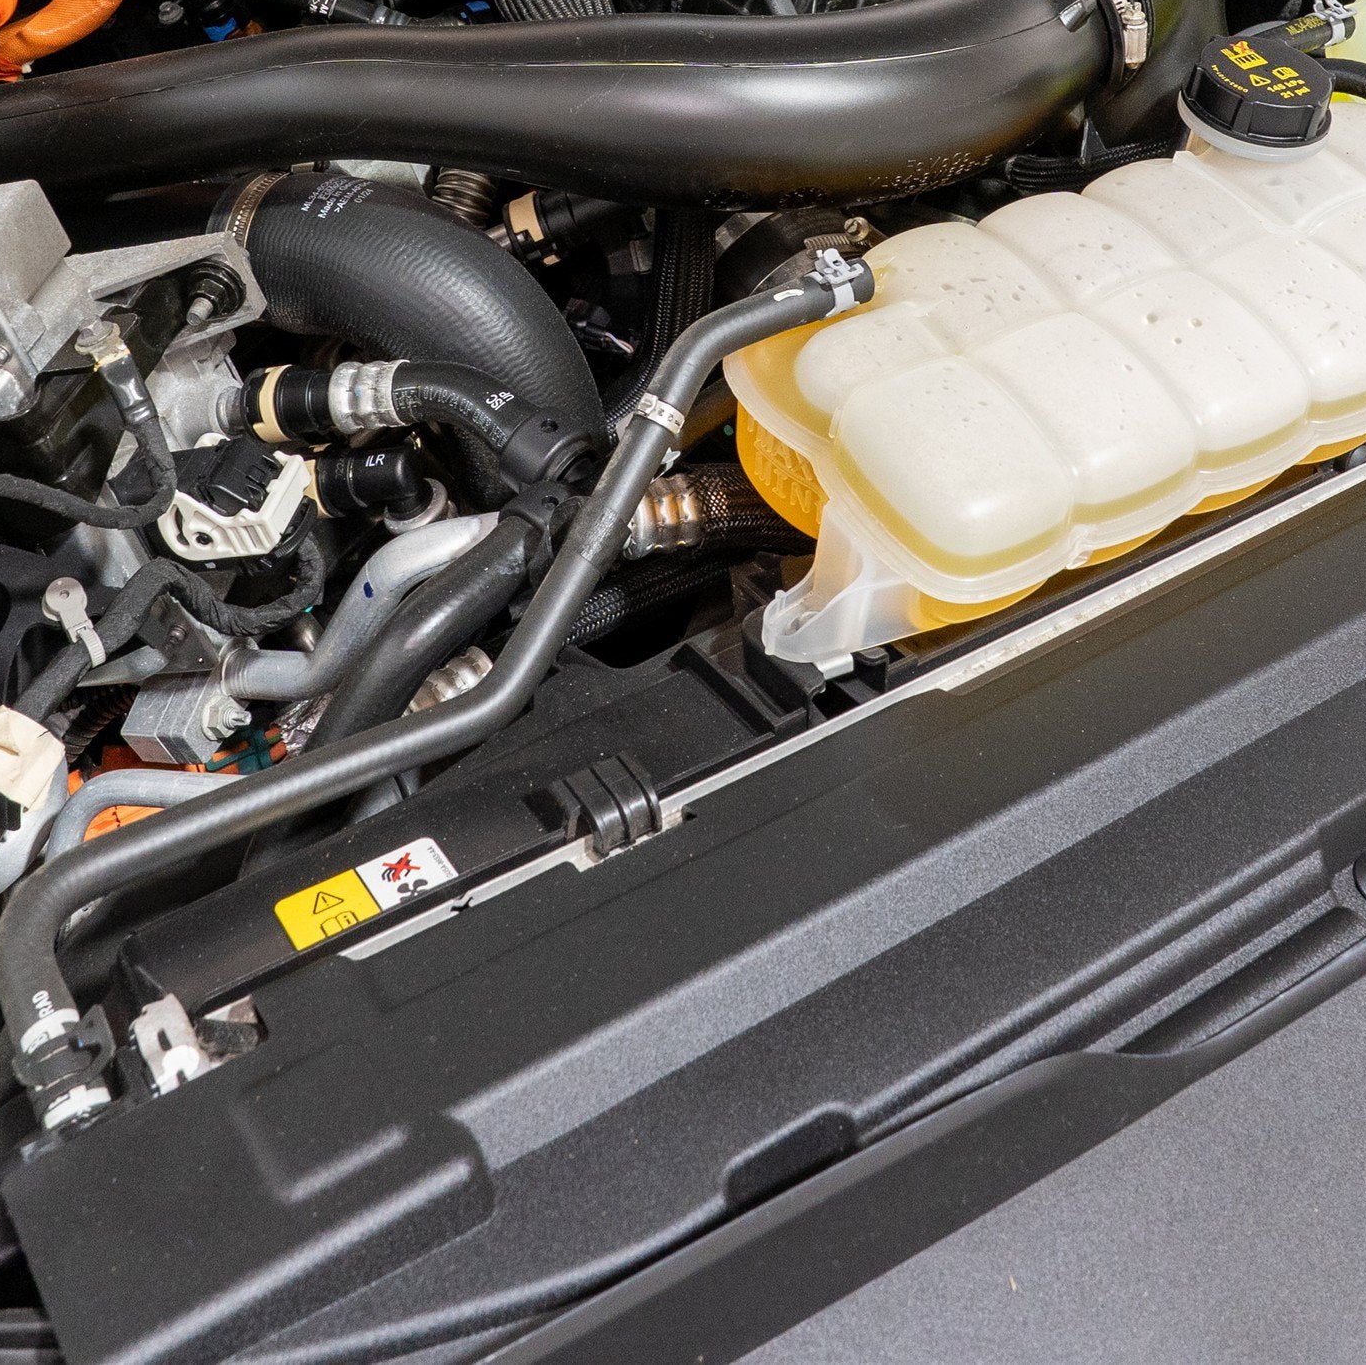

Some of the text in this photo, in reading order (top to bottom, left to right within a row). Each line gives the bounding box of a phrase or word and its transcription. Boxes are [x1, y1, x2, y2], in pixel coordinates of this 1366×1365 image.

[1284, 78, 1305, 89] kPa
[1280, 86, 1311, 99] 21 psi
[366, 454, 385, 467] ILR
[32, 990, 55, 1019] RAD
